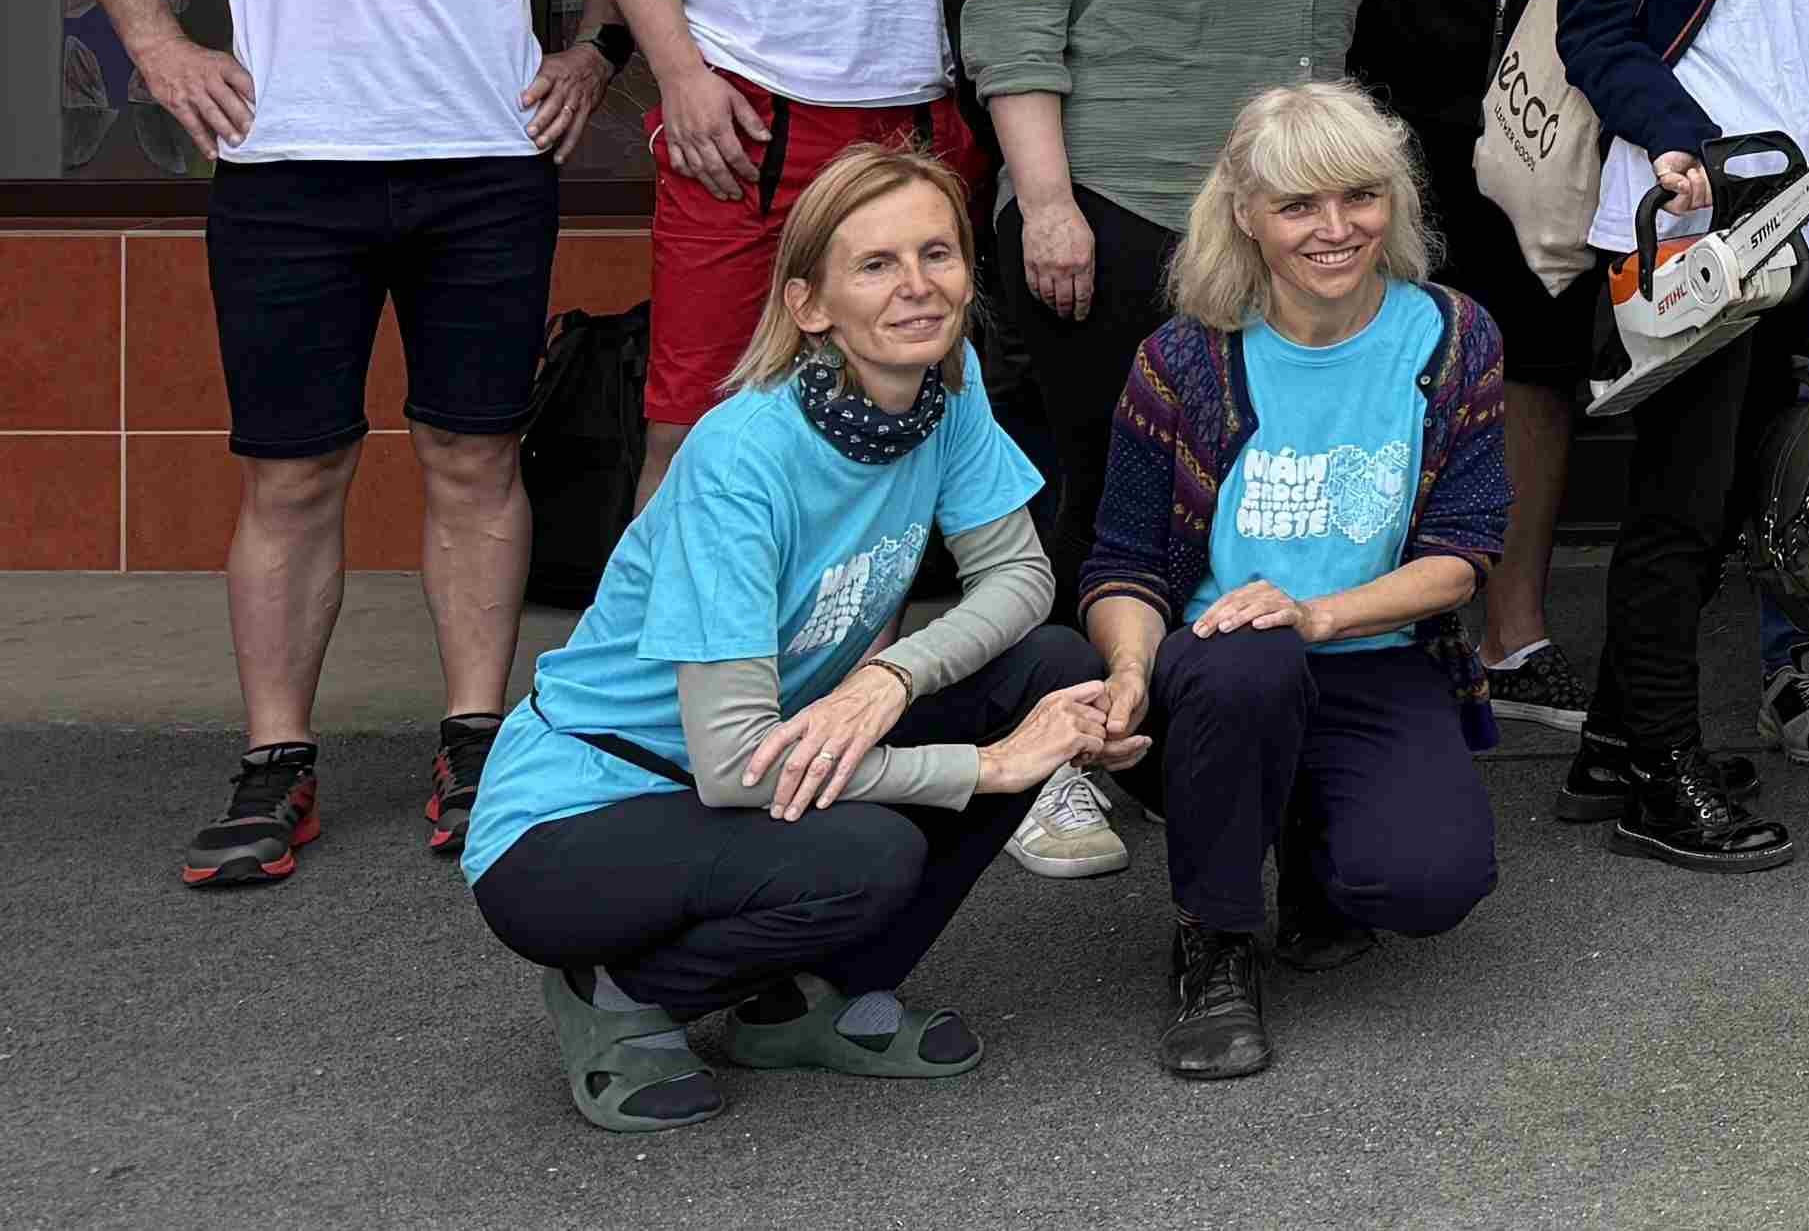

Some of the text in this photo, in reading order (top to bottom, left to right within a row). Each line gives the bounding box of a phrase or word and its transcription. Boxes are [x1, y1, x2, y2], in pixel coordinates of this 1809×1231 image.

[1498, 50, 1560, 159] ecco
[1751, 216, 1781, 249] STIHL
[1657, 282, 1688, 316] STIHL
[1243, 445, 1330, 485] MÁM
[1245, 480, 1322, 503] SRDCE
[1235, 505, 1331, 542] MESTE
